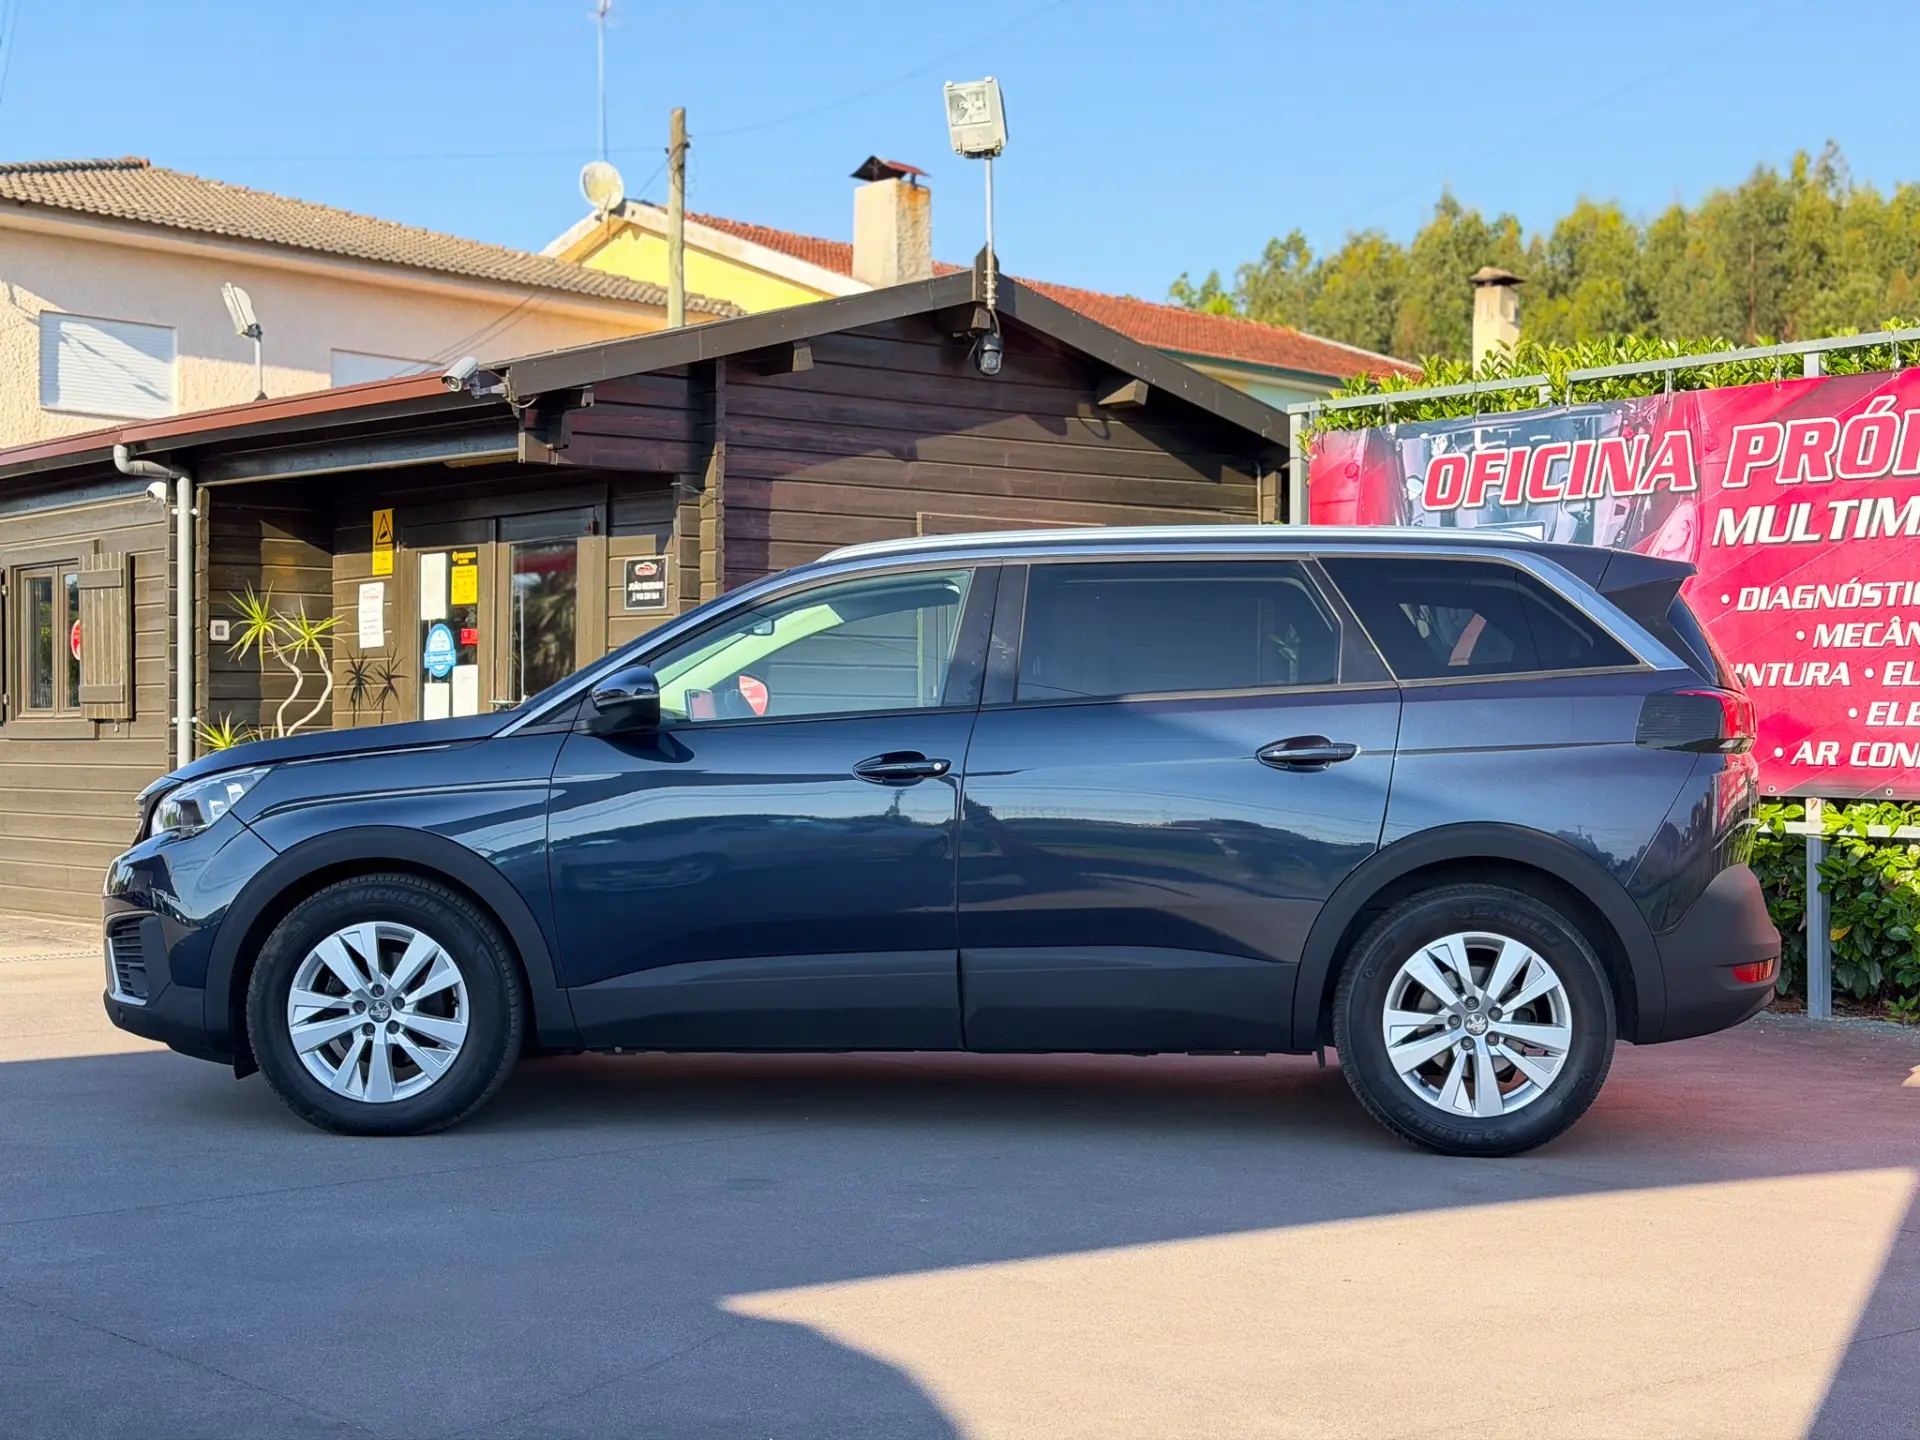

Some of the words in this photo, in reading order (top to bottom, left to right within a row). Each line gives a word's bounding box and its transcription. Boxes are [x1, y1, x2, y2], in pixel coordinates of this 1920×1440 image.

[1422, 430, 1697, 511] OFICINA
[1712, 495, 1920, 546] MULTIM
[1882, 661, 1920, 686] EL
[1790, 741, 1840, 766] AR
[1850, 742, 1920, 768] CON
[348, 889, 443, 915] MICHELIN
